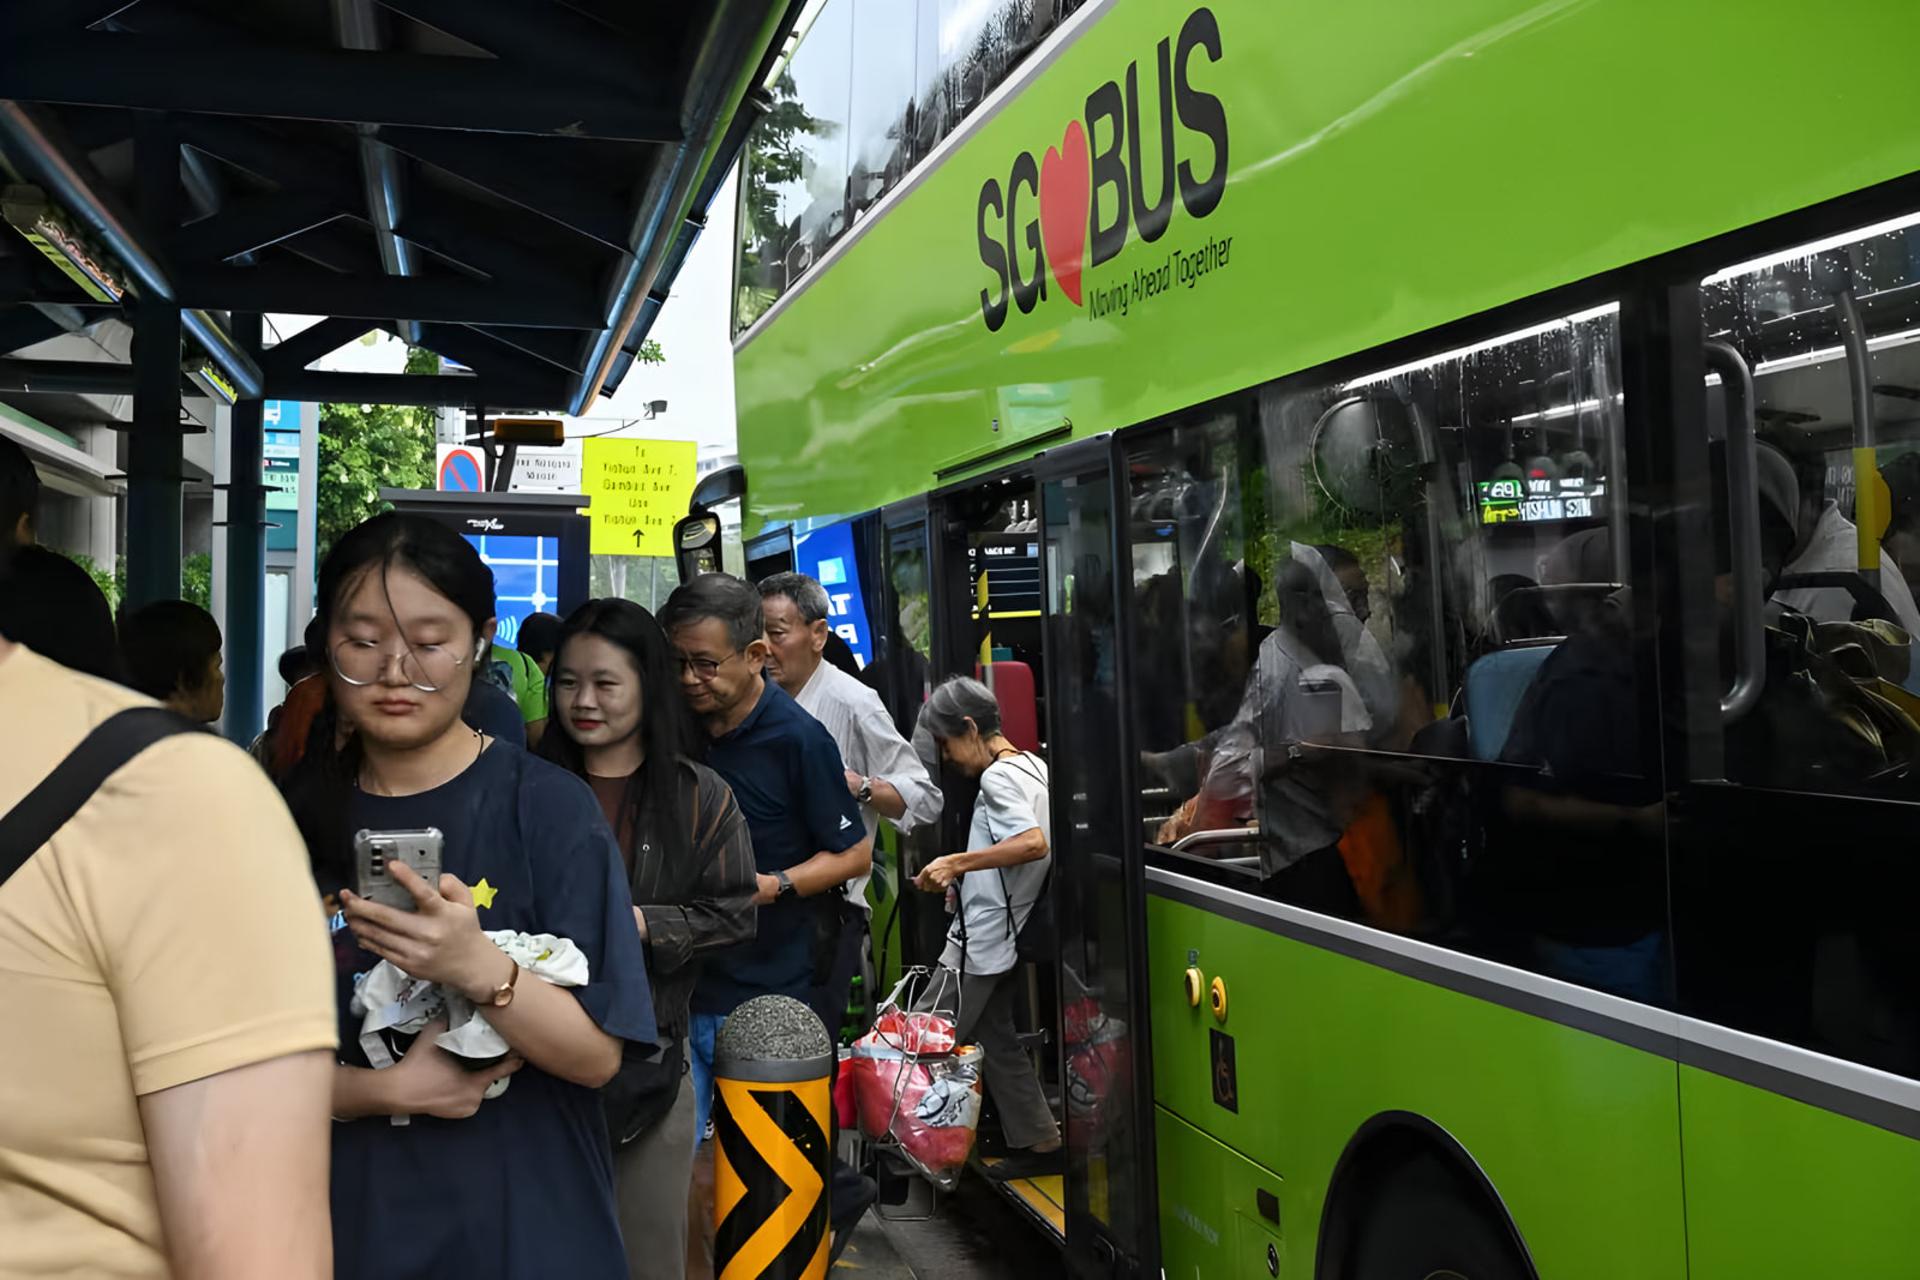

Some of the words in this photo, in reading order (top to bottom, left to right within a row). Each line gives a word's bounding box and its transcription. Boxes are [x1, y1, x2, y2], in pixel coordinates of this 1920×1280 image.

[1089, 280, 1128, 322] Moving
[1131, 255, 1170, 304] Ahead
[1173, 235, 1233, 289] Together
